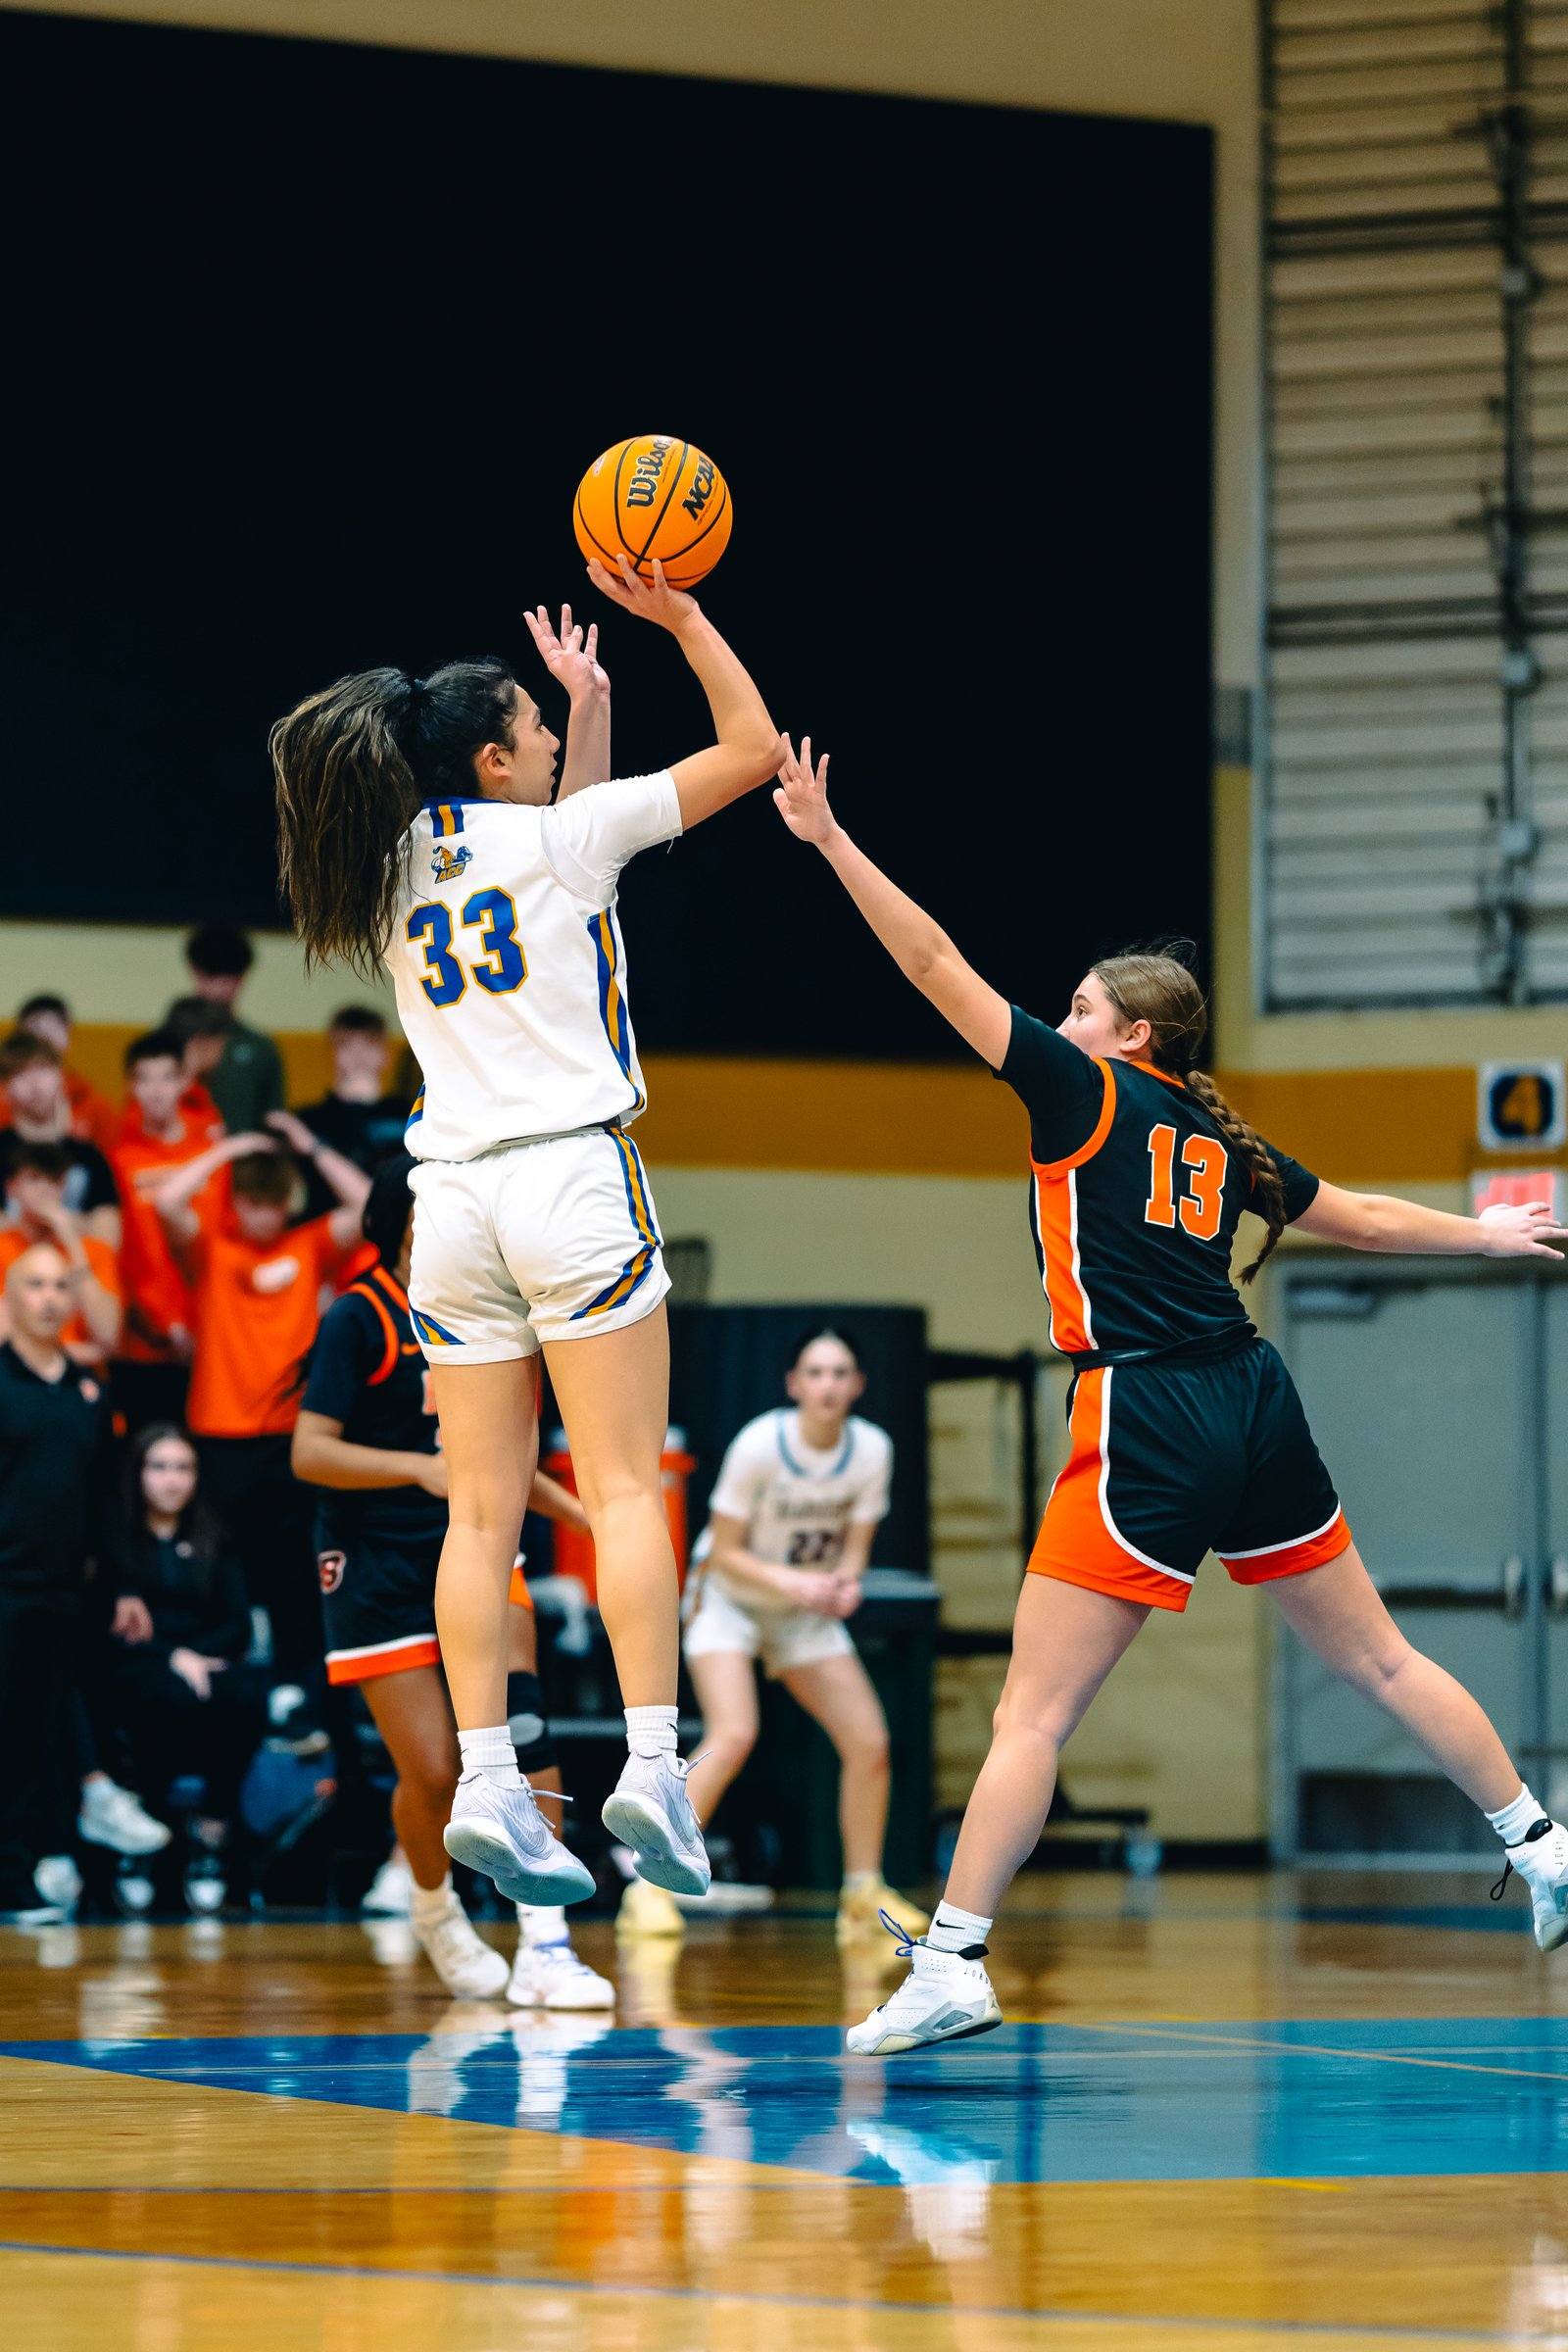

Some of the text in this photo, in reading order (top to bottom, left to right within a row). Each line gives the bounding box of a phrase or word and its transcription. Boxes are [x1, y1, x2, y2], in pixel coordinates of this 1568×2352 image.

[681, 455, 715, 521] NCAA
[437, 863, 465, 883] ACC
[405, 885, 529, 1010] 33
[1500, 1074, 1544, 1137] 4
[1145, 1123, 1228, 1242] 13
